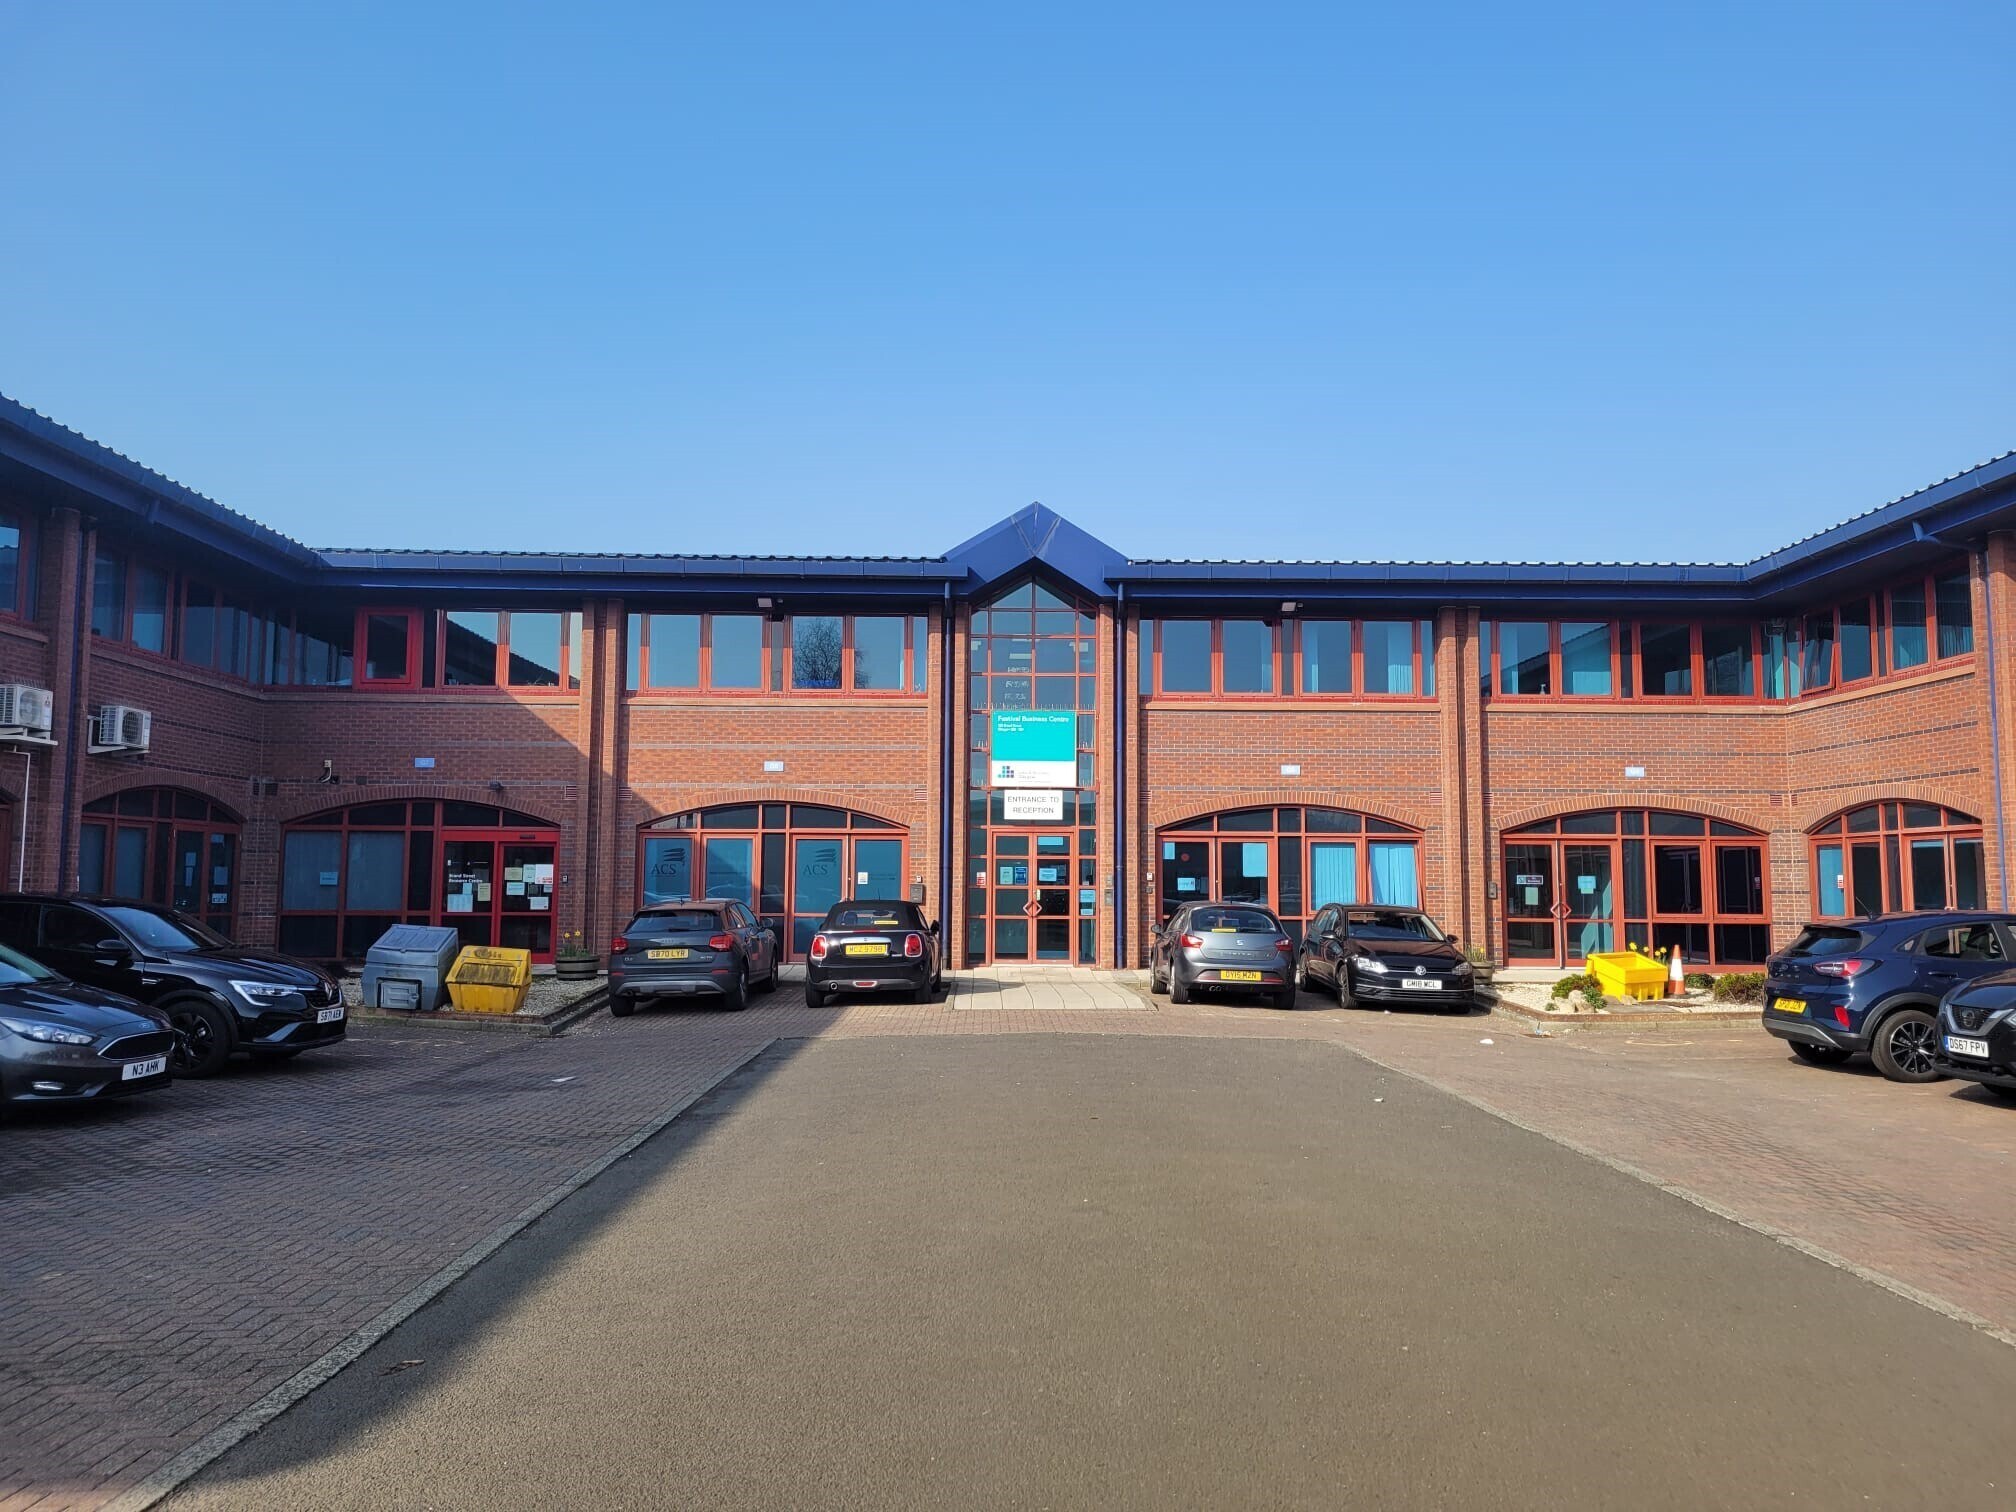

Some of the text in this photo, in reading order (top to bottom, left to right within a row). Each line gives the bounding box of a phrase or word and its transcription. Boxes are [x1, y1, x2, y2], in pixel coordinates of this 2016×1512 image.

[1049, 715, 1070, 723] Centre
[651, 864, 676, 875] ACS
[804, 864, 828, 875] ACS
[1949, 1038, 1985, 1054] DS67 FPV
[132, 1064, 144, 1077] N3
